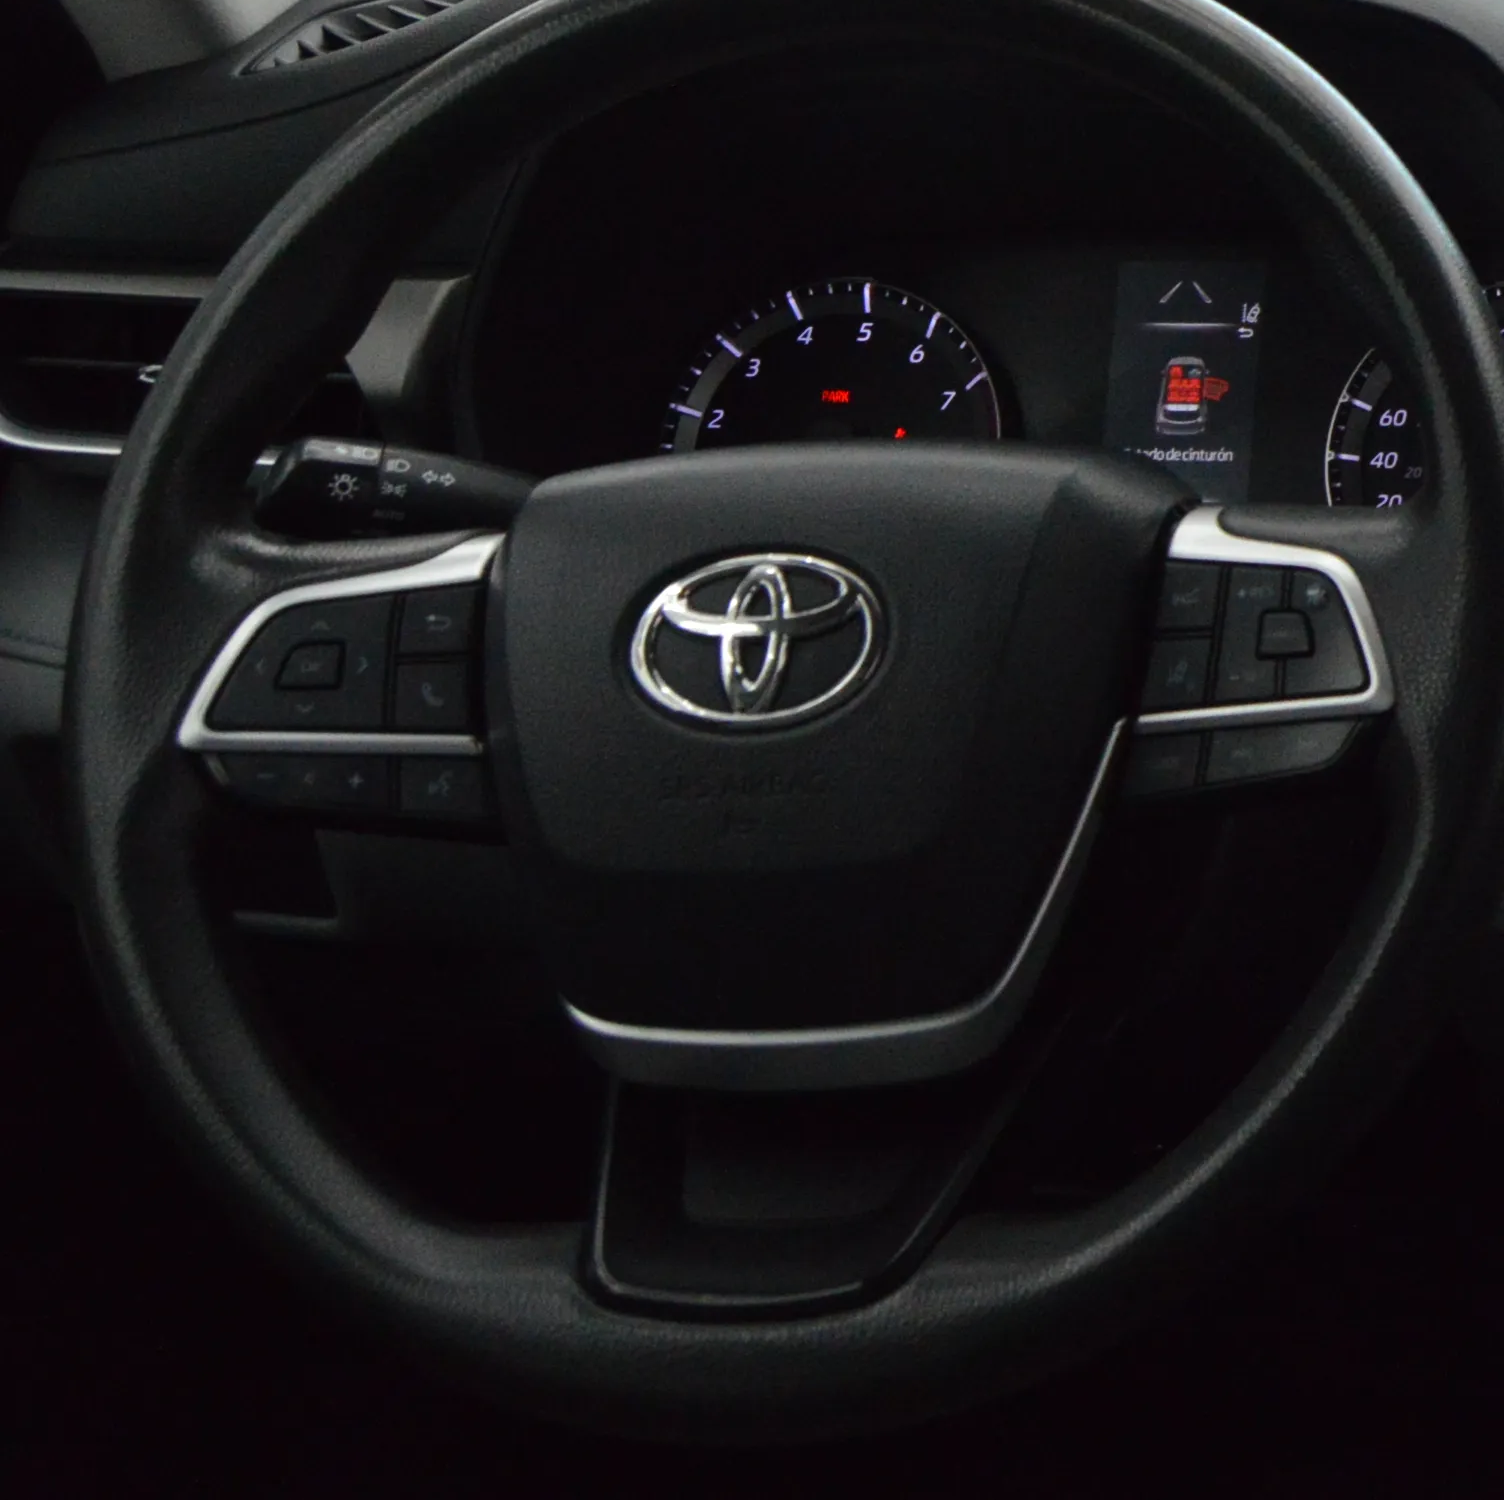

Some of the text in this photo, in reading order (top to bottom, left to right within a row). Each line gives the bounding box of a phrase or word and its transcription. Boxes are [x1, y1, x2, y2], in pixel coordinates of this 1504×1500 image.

[797, 325, 814, 345] 4
[856, 322, 873, 342] 5
[908, 344, 924, 363] 6
[745, 358, 761, 377] 3
[940, 390, 956, 410] 7
[707, 409, 725, 429] 2
[1379, 408, 1407, 427] 60
[1369, 450, 1398, 469] 40
